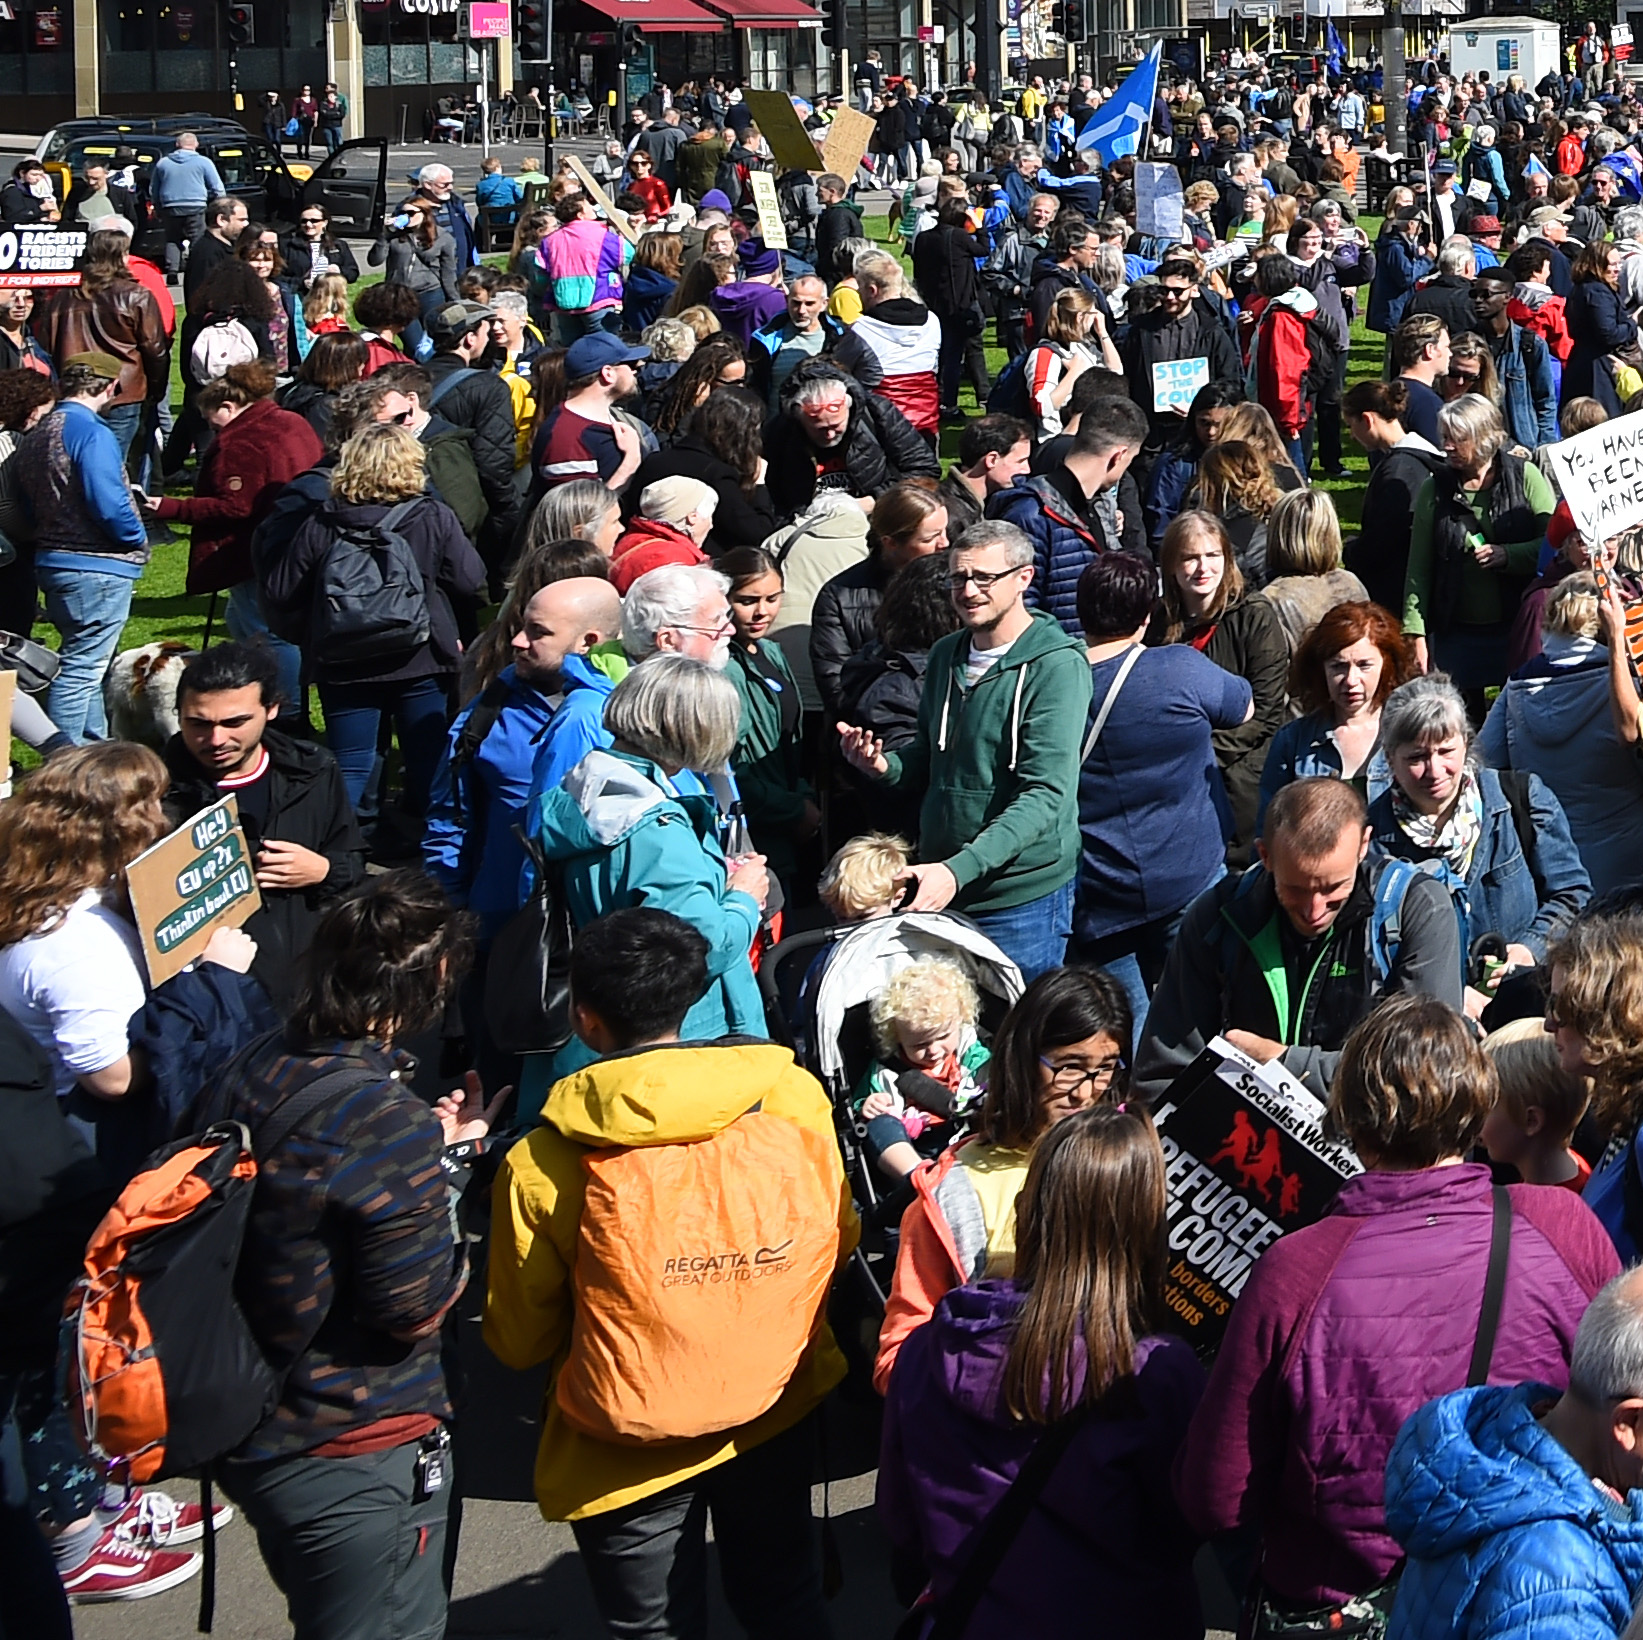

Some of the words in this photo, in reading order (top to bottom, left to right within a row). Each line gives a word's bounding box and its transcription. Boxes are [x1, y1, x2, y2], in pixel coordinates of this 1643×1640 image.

[20, 244, 87, 258] TRIDENT
[21, 231, 87, 245] RACISTS
[18, 256, 75, 270] TORIES
[8, 276, 32, 286] FOR
[1155, 358, 1206, 380] STOP
[177, 867, 202, 895] EU
[231, 865, 249, 895] EU
[1235, 1072, 1306, 1136] Socialist
[1300, 1123, 1360, 1178] Worker
[1160, 1135, 1285, 1260] REFUGEE
[661, 1271, 707, 1289] GREAT
[709, 1262, 793, 1284] OUTDOORS
[664, 1253, 750, 1274] REGATTA
[1168, 1260, 1230, 1317] borders
[1162, 1284, 1204, 1328] tions
